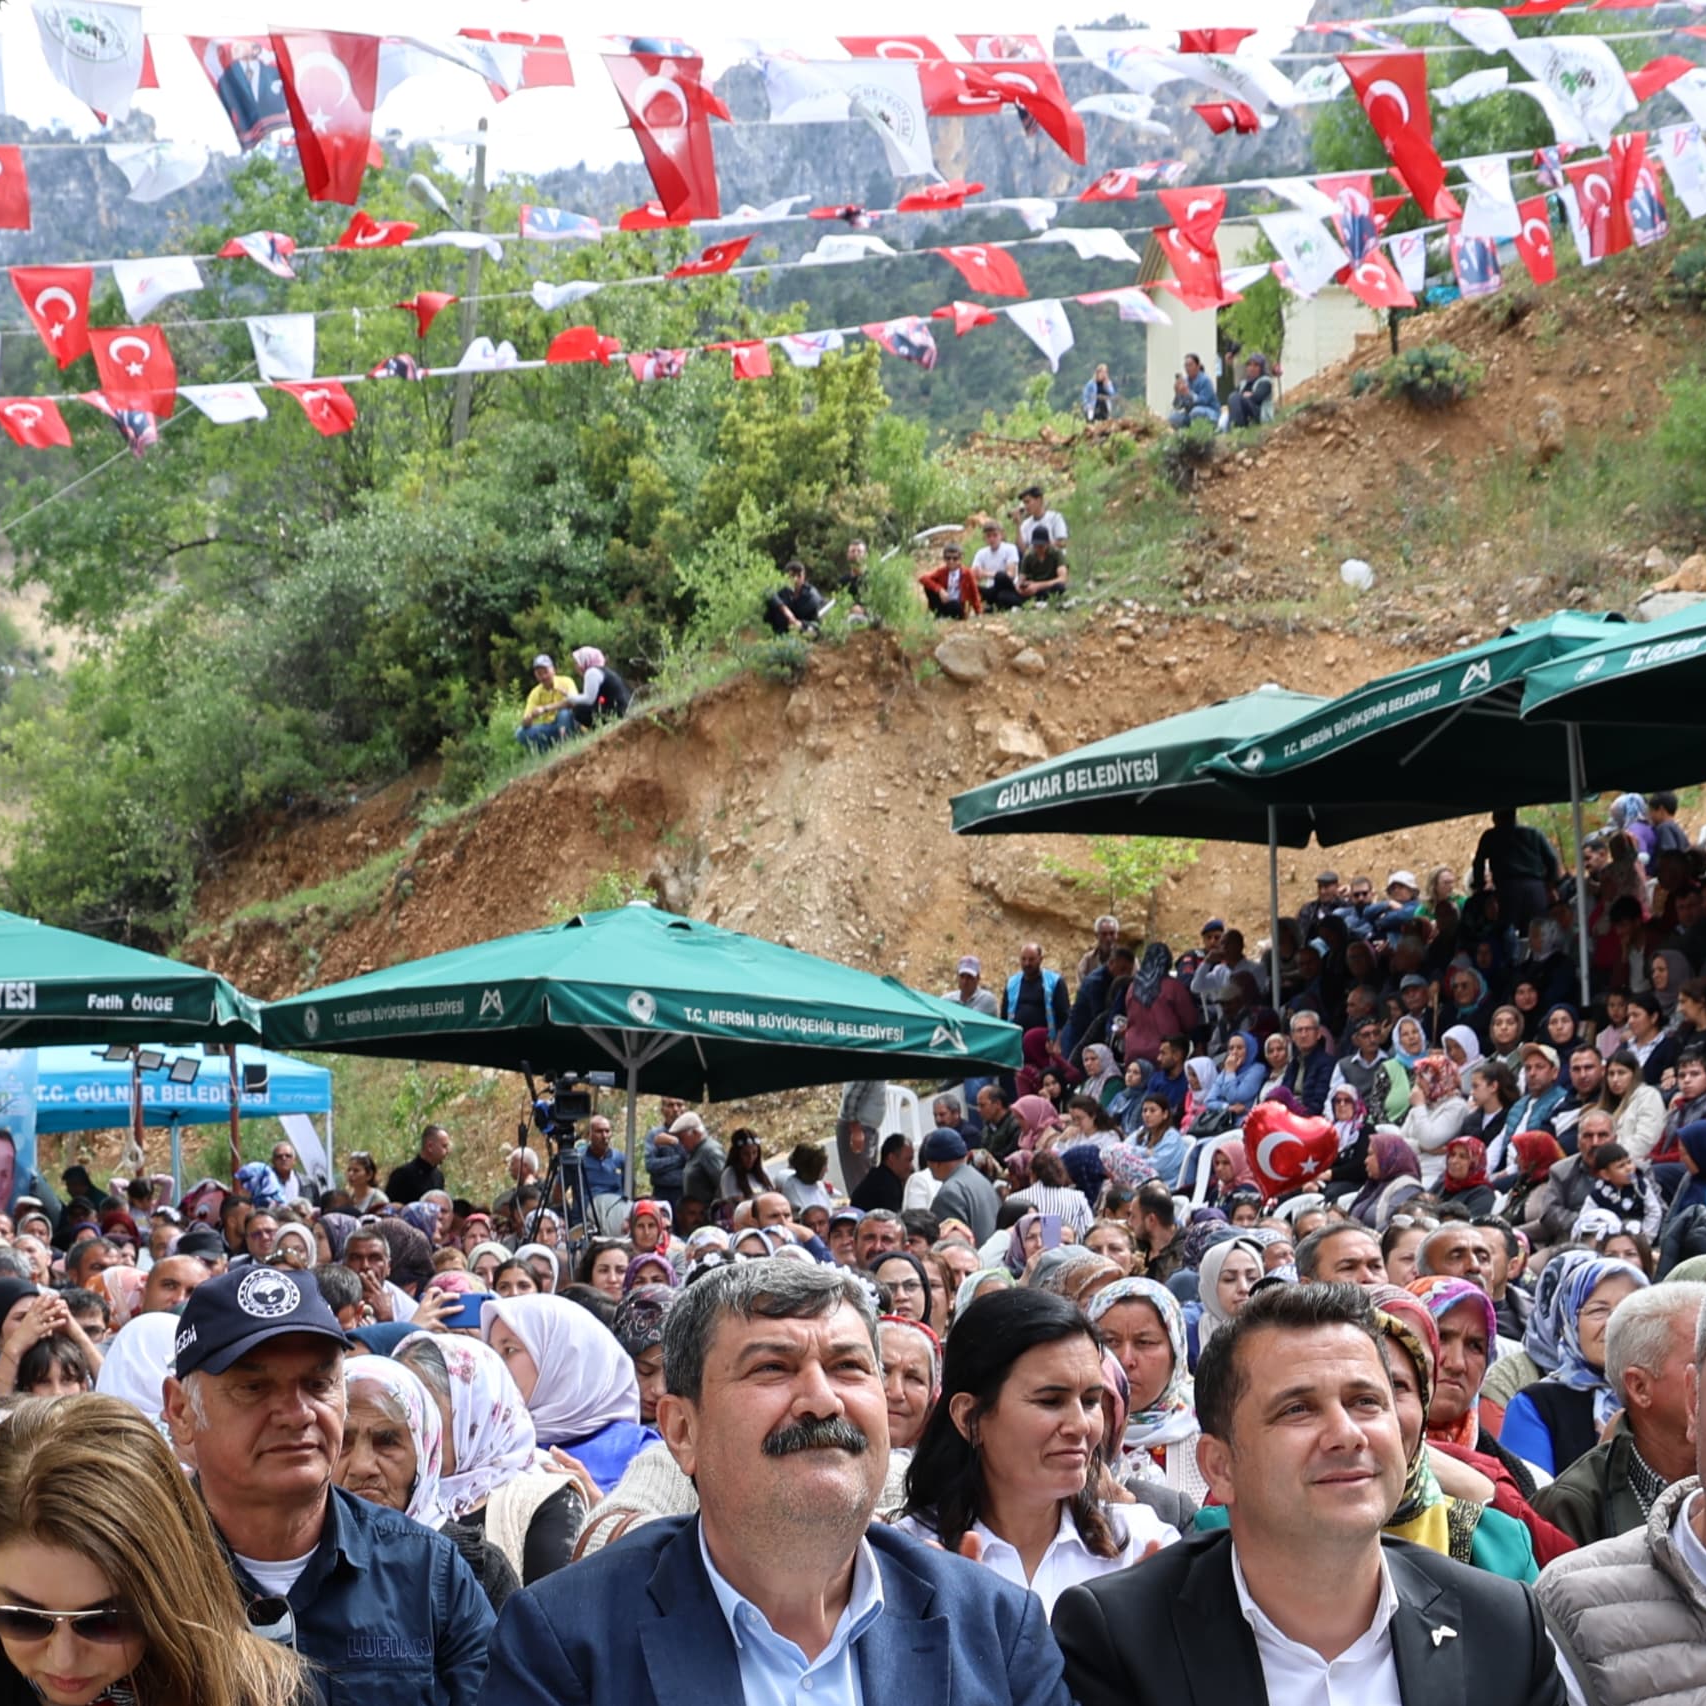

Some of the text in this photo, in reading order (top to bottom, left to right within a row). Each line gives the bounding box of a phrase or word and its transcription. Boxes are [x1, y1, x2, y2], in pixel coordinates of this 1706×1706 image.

[1300, 725, 1333, 751] MERSİN
[1333, 700, 1388, 737] BÜYÜKŞEHİR
[1388, 680, 1442, 714] BELEDİYESİ
[996, 752, 1160, 809] GÜLNAR BELEDİYESİ
[87, 993, 124, 1010] Fatih
[131, 992, 173, 1012] ÖNGE
[346, 1009, 372, 1025] MERSİN
[373, 1002, 419, 1021] BÜYÜKŞEHİR
[420, 997, 465, 1017] BELEDİYESİ
[683, 1007, 904, 1042] T.C. MERSİN BÜYÜKŞEHİR BELEDİYESİ
[34, 1085, 69, 1102] T.C.
[75, 1083, 155, 1102] GÜLNR
[161, 1083, 270, 1104] BELEDİESİ
[347, 1635, 432, 1658] LUFIAN
